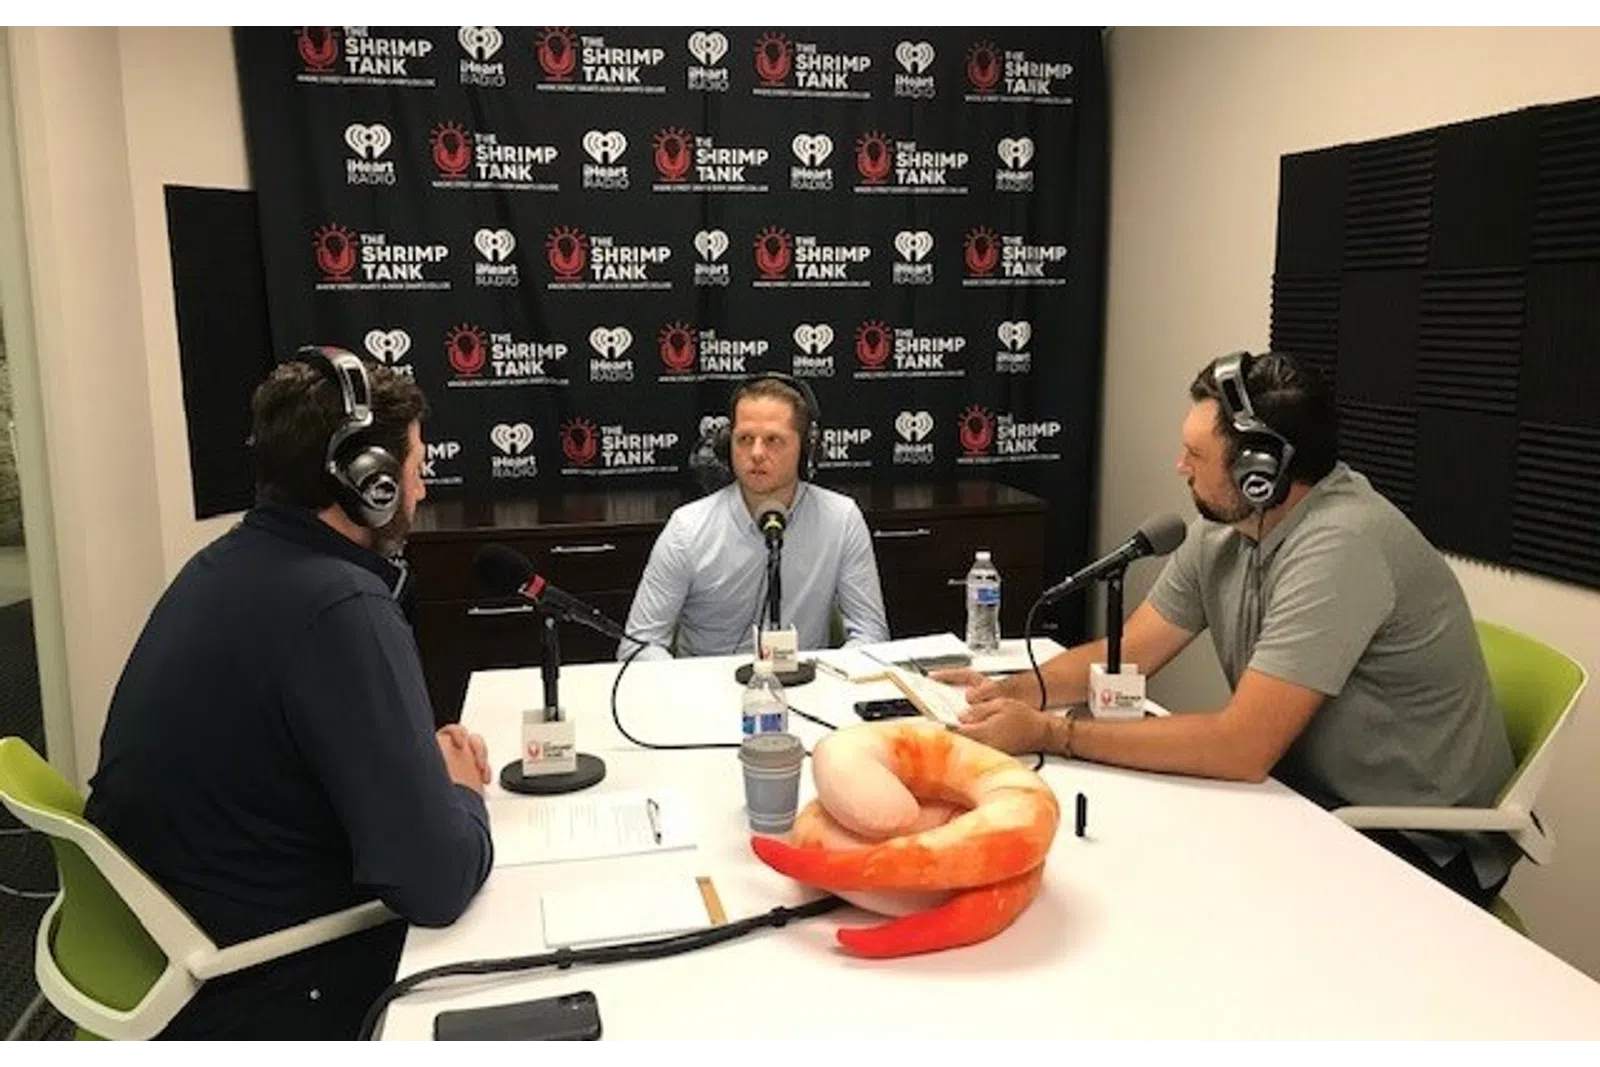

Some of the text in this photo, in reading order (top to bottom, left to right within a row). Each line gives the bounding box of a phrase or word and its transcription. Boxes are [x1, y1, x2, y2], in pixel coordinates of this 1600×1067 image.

[345, 38, 434, 58] SHRIMP
[580, 36, 604, 47] THE
[795, 43, 816, 54] THE
[582, 48, 666, 66] SHRIMP
[795, 54, 872, 72] SHRIMP
[345, 56, 408, 76] TANK
[460, 59, 504, 74] iHeart
[1004, 61, 1073, 79] SHRIMP
[460, 74, 506, 87] RADIO
[583, 66, 641, 83] TANK
[795, 72, 849, 90] TANK
[894, 74, 934, 88] iHeart
[1004, 78, 1050, 95] TANK
[474, 133, 498, 144] THE
[476, 146, 558, 164] SHRIMP
[696, 149, 769, 166] SHRIMP
[896, 152, 968, 168] SHRIMP
[347, 159, 394, 173] iHeart
[476, 164, 532, 181] TANK
[583, 164, 628, 178] iHeart
[696, 166, 745, 182] TANK
[348, 172, 396, 184] RADIO
[583, 178, 630, 190] RADIO
[896, 169, 946, 185] TANK
[360, 234, 386, 245] THE
[590, 236, 614, 247] THE
[795, 236, 816, 247] THE
[361, 246, 449, 262] SHRIMP
[590, 247, 672, 264] SHRIMP
[795, 246, 871, 262] SHRIMP
[1002, 246, 1067, 261] SHRIMP
[361, 264, 424, 280] TANK
[475, 262, 518, 276] iHeart
[590, 264, 648, 281] TANK
[795, 263, 846, 280] TANK
[1002, 261, 1044, 278] TANK
[475, 276, 520, 286] RADIO
[490, 334, 512, 344] THE
[894, 337, 966, 353] SHRIMP
[492, 344, 568, 361] SHRIMP
[700, 340, 768, 357] SHRIMP
[492, 360, 546, 377] TANK
[590, 358, 633, 372] iHeart
[700, 356, 746, 373] TANK
[792, 356, 834, 368] iHeart
[894, 354, 944, 370] TANK
[591, 372, 634, 382] RADIO
[602, 426, 622, 436] THE
[824, 429, 872, 444] RIMP
[998, 422, 1061, 439] SHRIMP
[602, 434, 678, 450] SHRIMP
[997, 439, 1038, 454] TANK
[492, 454, 536, 468] iHeart
[602, 450, 656, 467] TANK
[492, 466, 538, 478] RADIO
